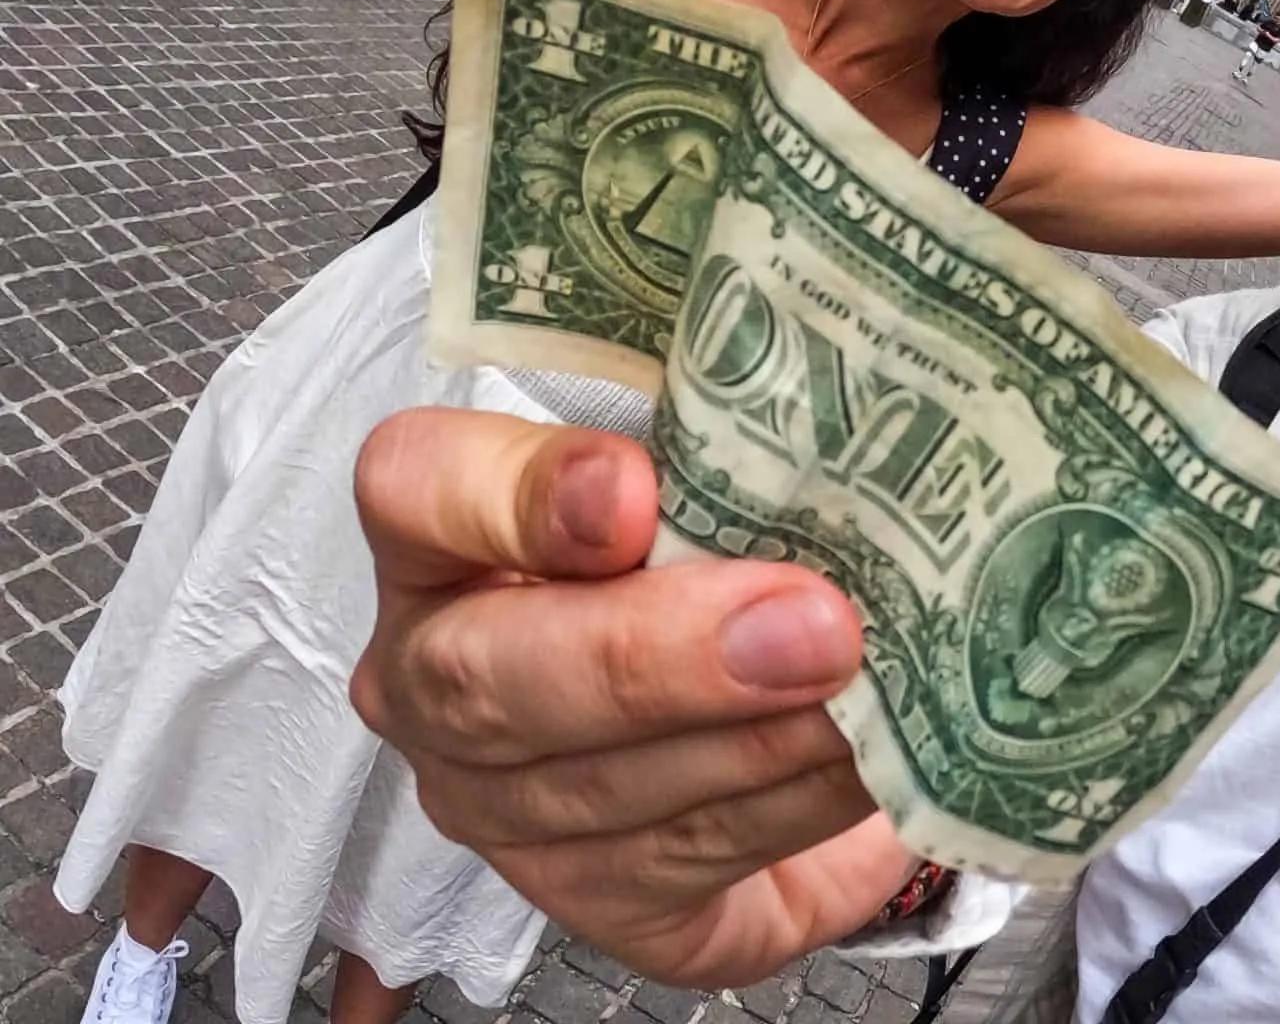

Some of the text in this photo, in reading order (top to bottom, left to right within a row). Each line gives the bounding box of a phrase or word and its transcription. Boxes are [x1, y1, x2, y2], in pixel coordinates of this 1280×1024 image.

[512, 17, 606, 57] ONE
[484, 263, 574, 296] ONE
[648, 24, 1265, 530] THE ITED STATES OF AMERICA
[770, 255, 979, 395] IN GOD WE TRUST
[676, 255, 1012, 574] ONE
